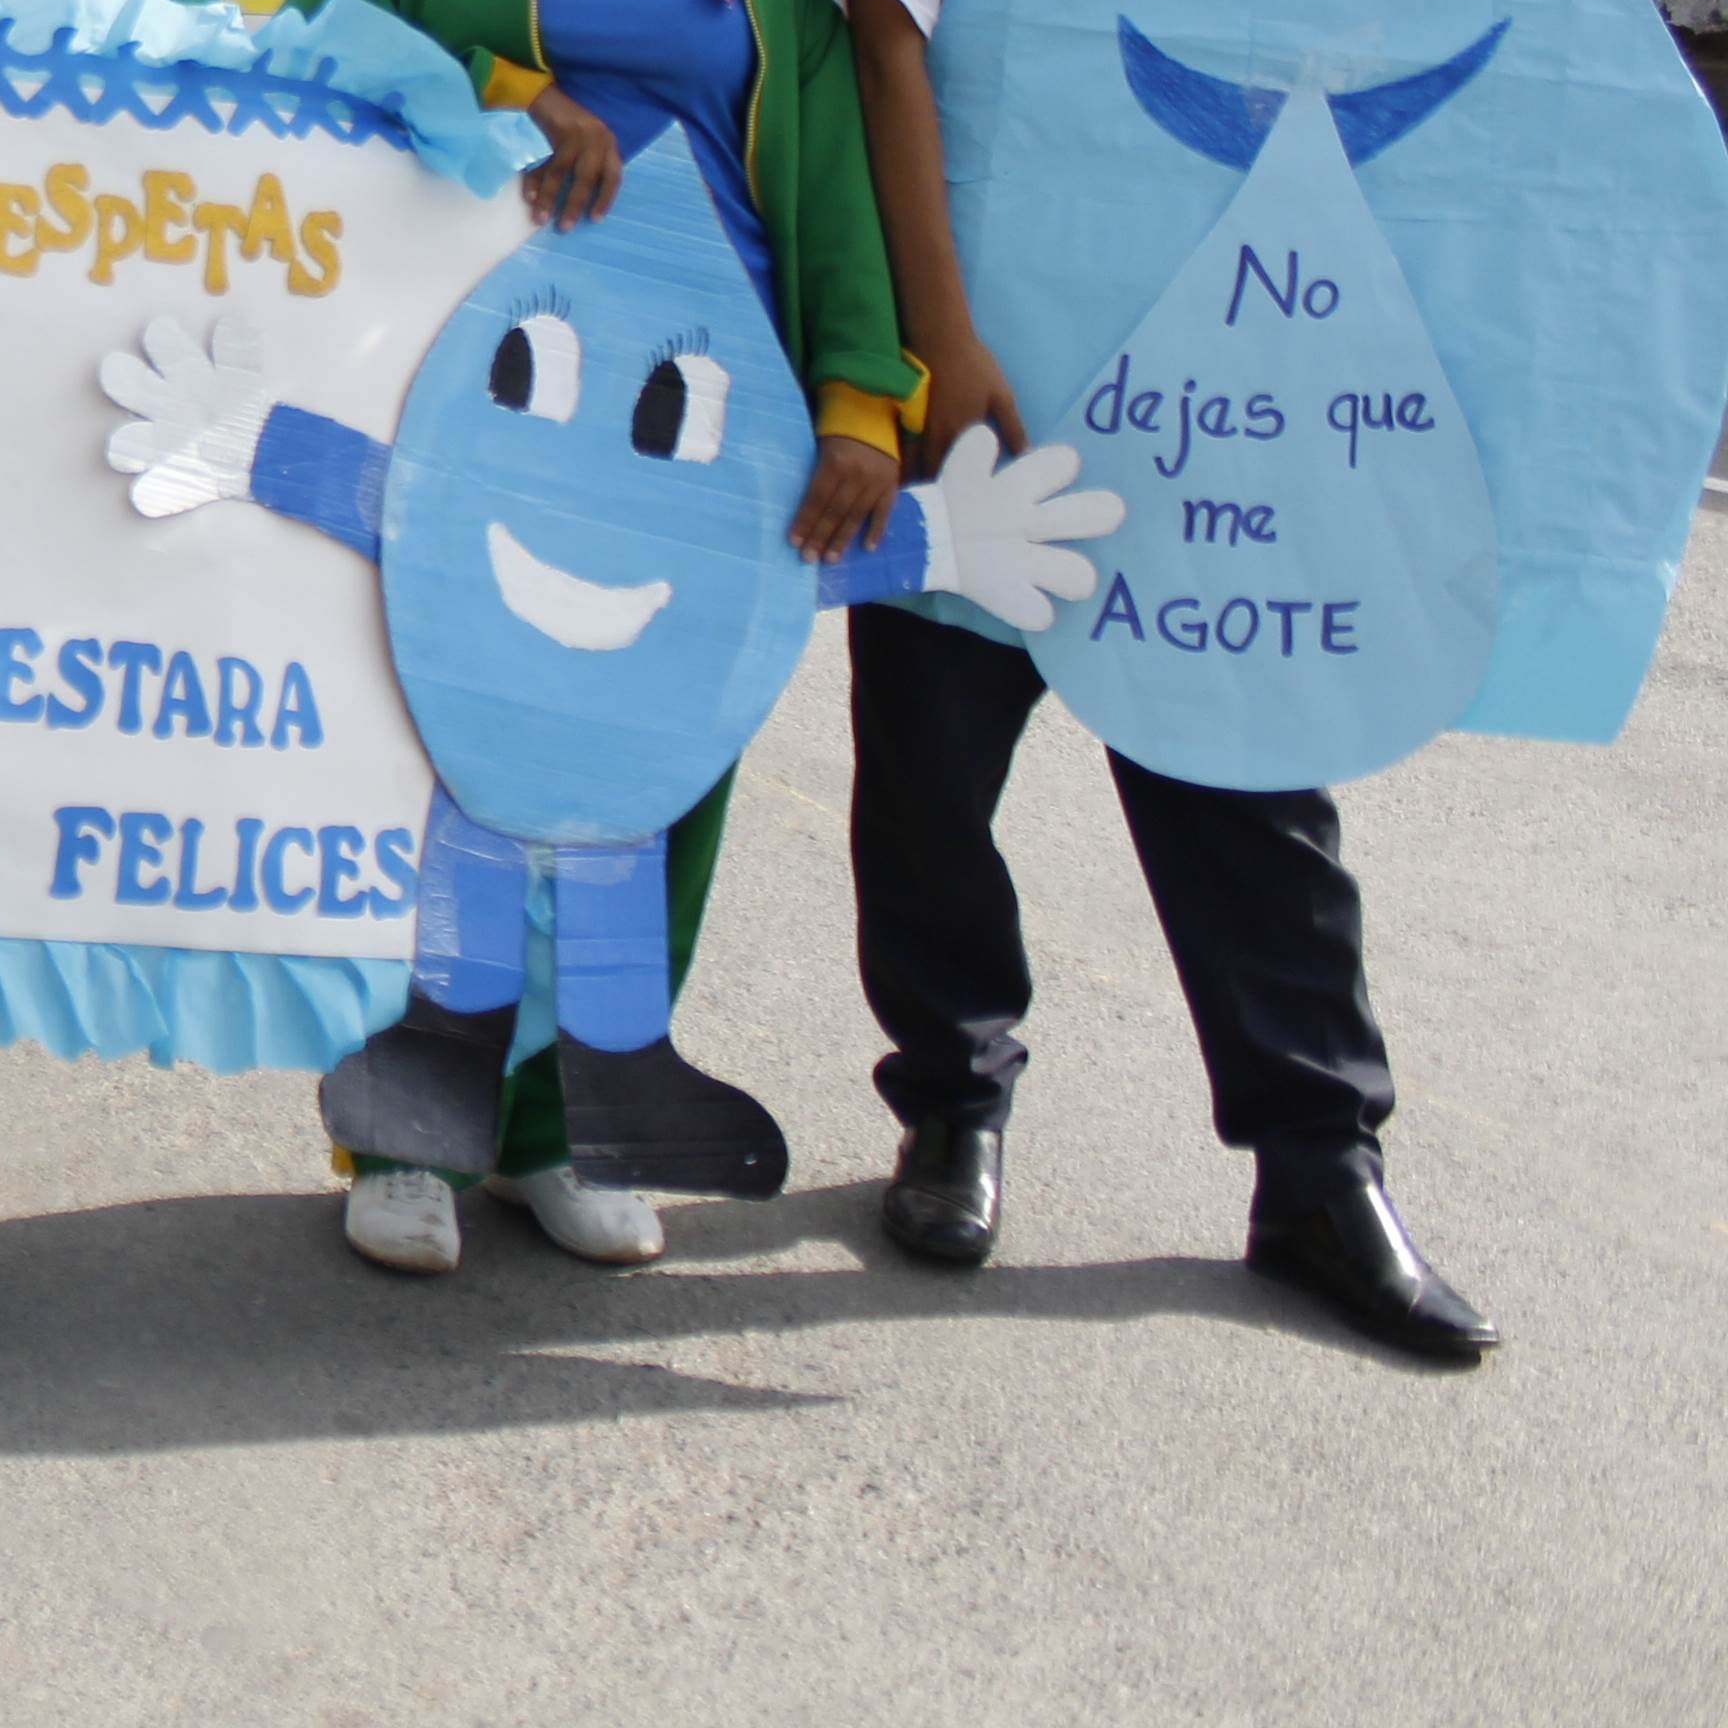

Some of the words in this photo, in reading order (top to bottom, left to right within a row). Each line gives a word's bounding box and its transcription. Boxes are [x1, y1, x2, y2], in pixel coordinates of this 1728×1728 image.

[1224, 243, 1340, 327] No
[1083, 353, 1286, 479] dejas
[1326, 390, 1436, 469] que
[1181, 498, 1278, 547] me
[1089, 570, 1361, 658] AGOTE
[48, 804, 418, 921] FELICES
